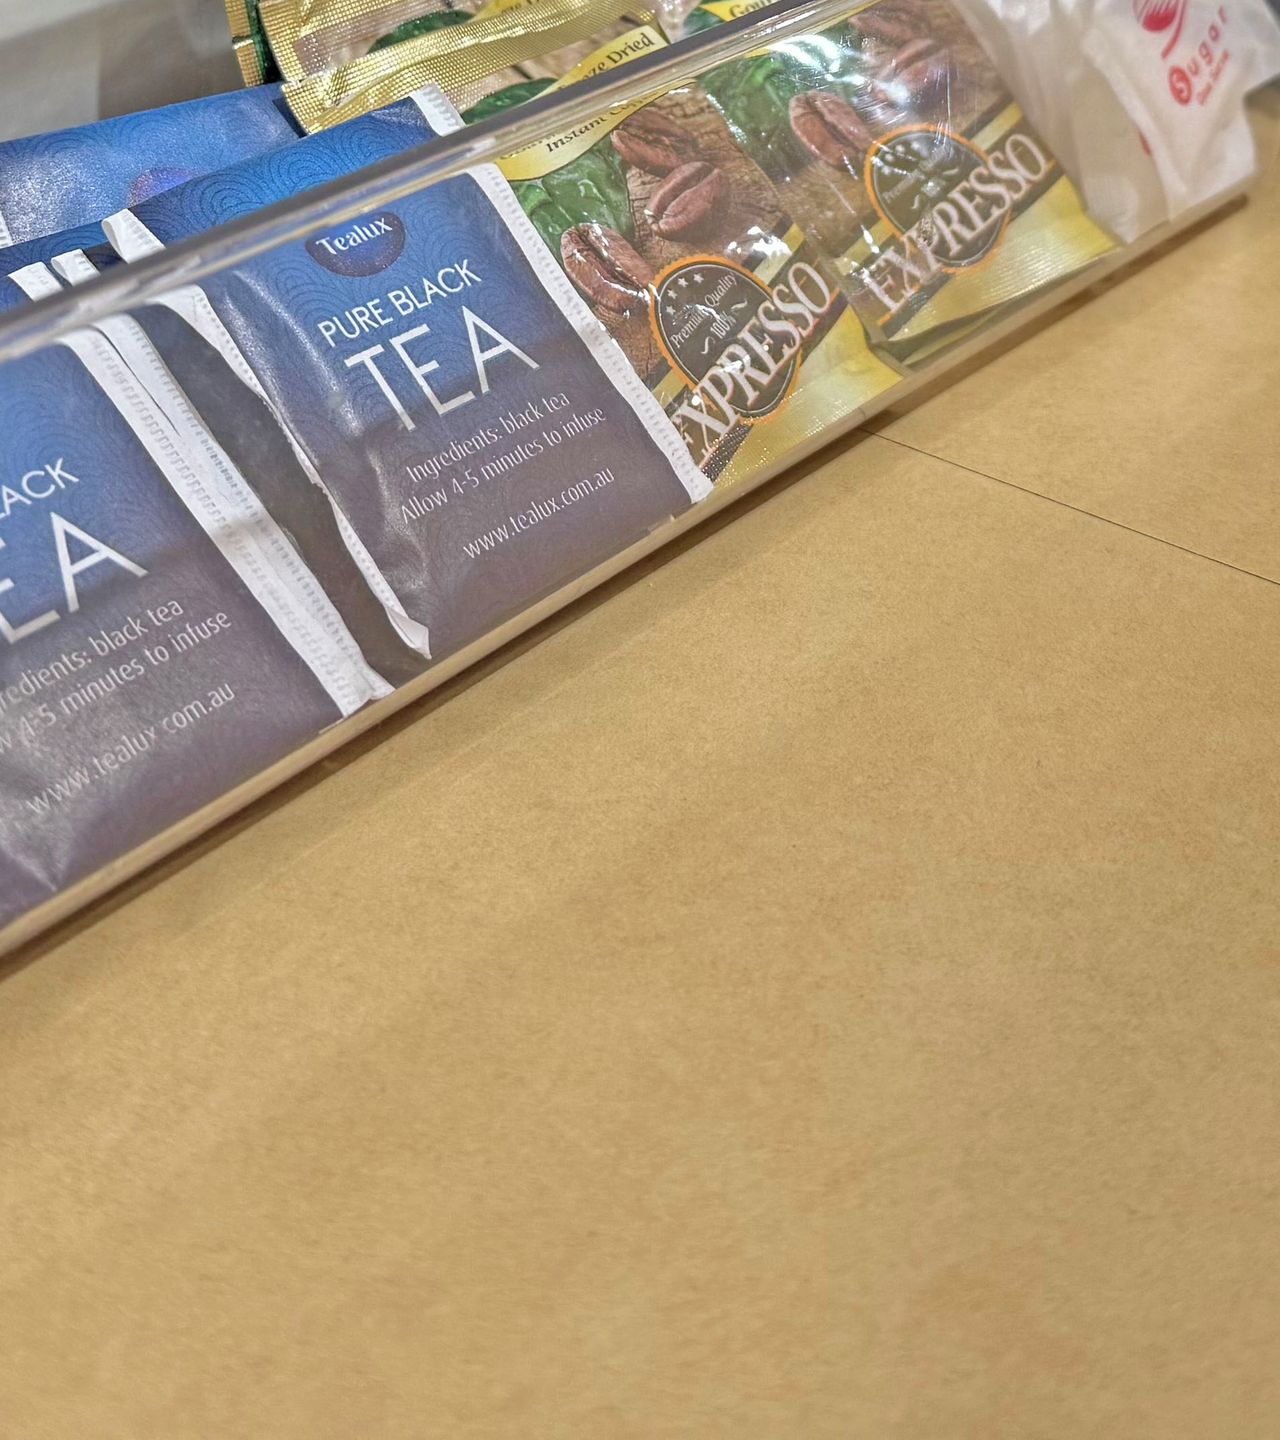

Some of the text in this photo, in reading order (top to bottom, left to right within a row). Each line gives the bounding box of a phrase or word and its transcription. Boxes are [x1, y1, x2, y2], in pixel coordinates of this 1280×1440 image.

[607, 32, 656, 64] Dried
[316, 217, 393, 255] Tealux
[317, 259, 482, 348] PURE BLACK
[670, 305, 714, 349] Premiu
[343, 305, 541, 432] TEA
[400, 407, 607, 525] Allow 4-5 minutes to infuse
[406, 392, 570, 484] Ingredients: black tea
[462, 467, 616, 560] www.tealux.com.au
[60, 654, 146, 716] minutes
[144, 643, 170, 667] to
[171, 610, 233, 655] infuse
[88, 616, 149, 658] black
[146, 599, 185, 628] tea
